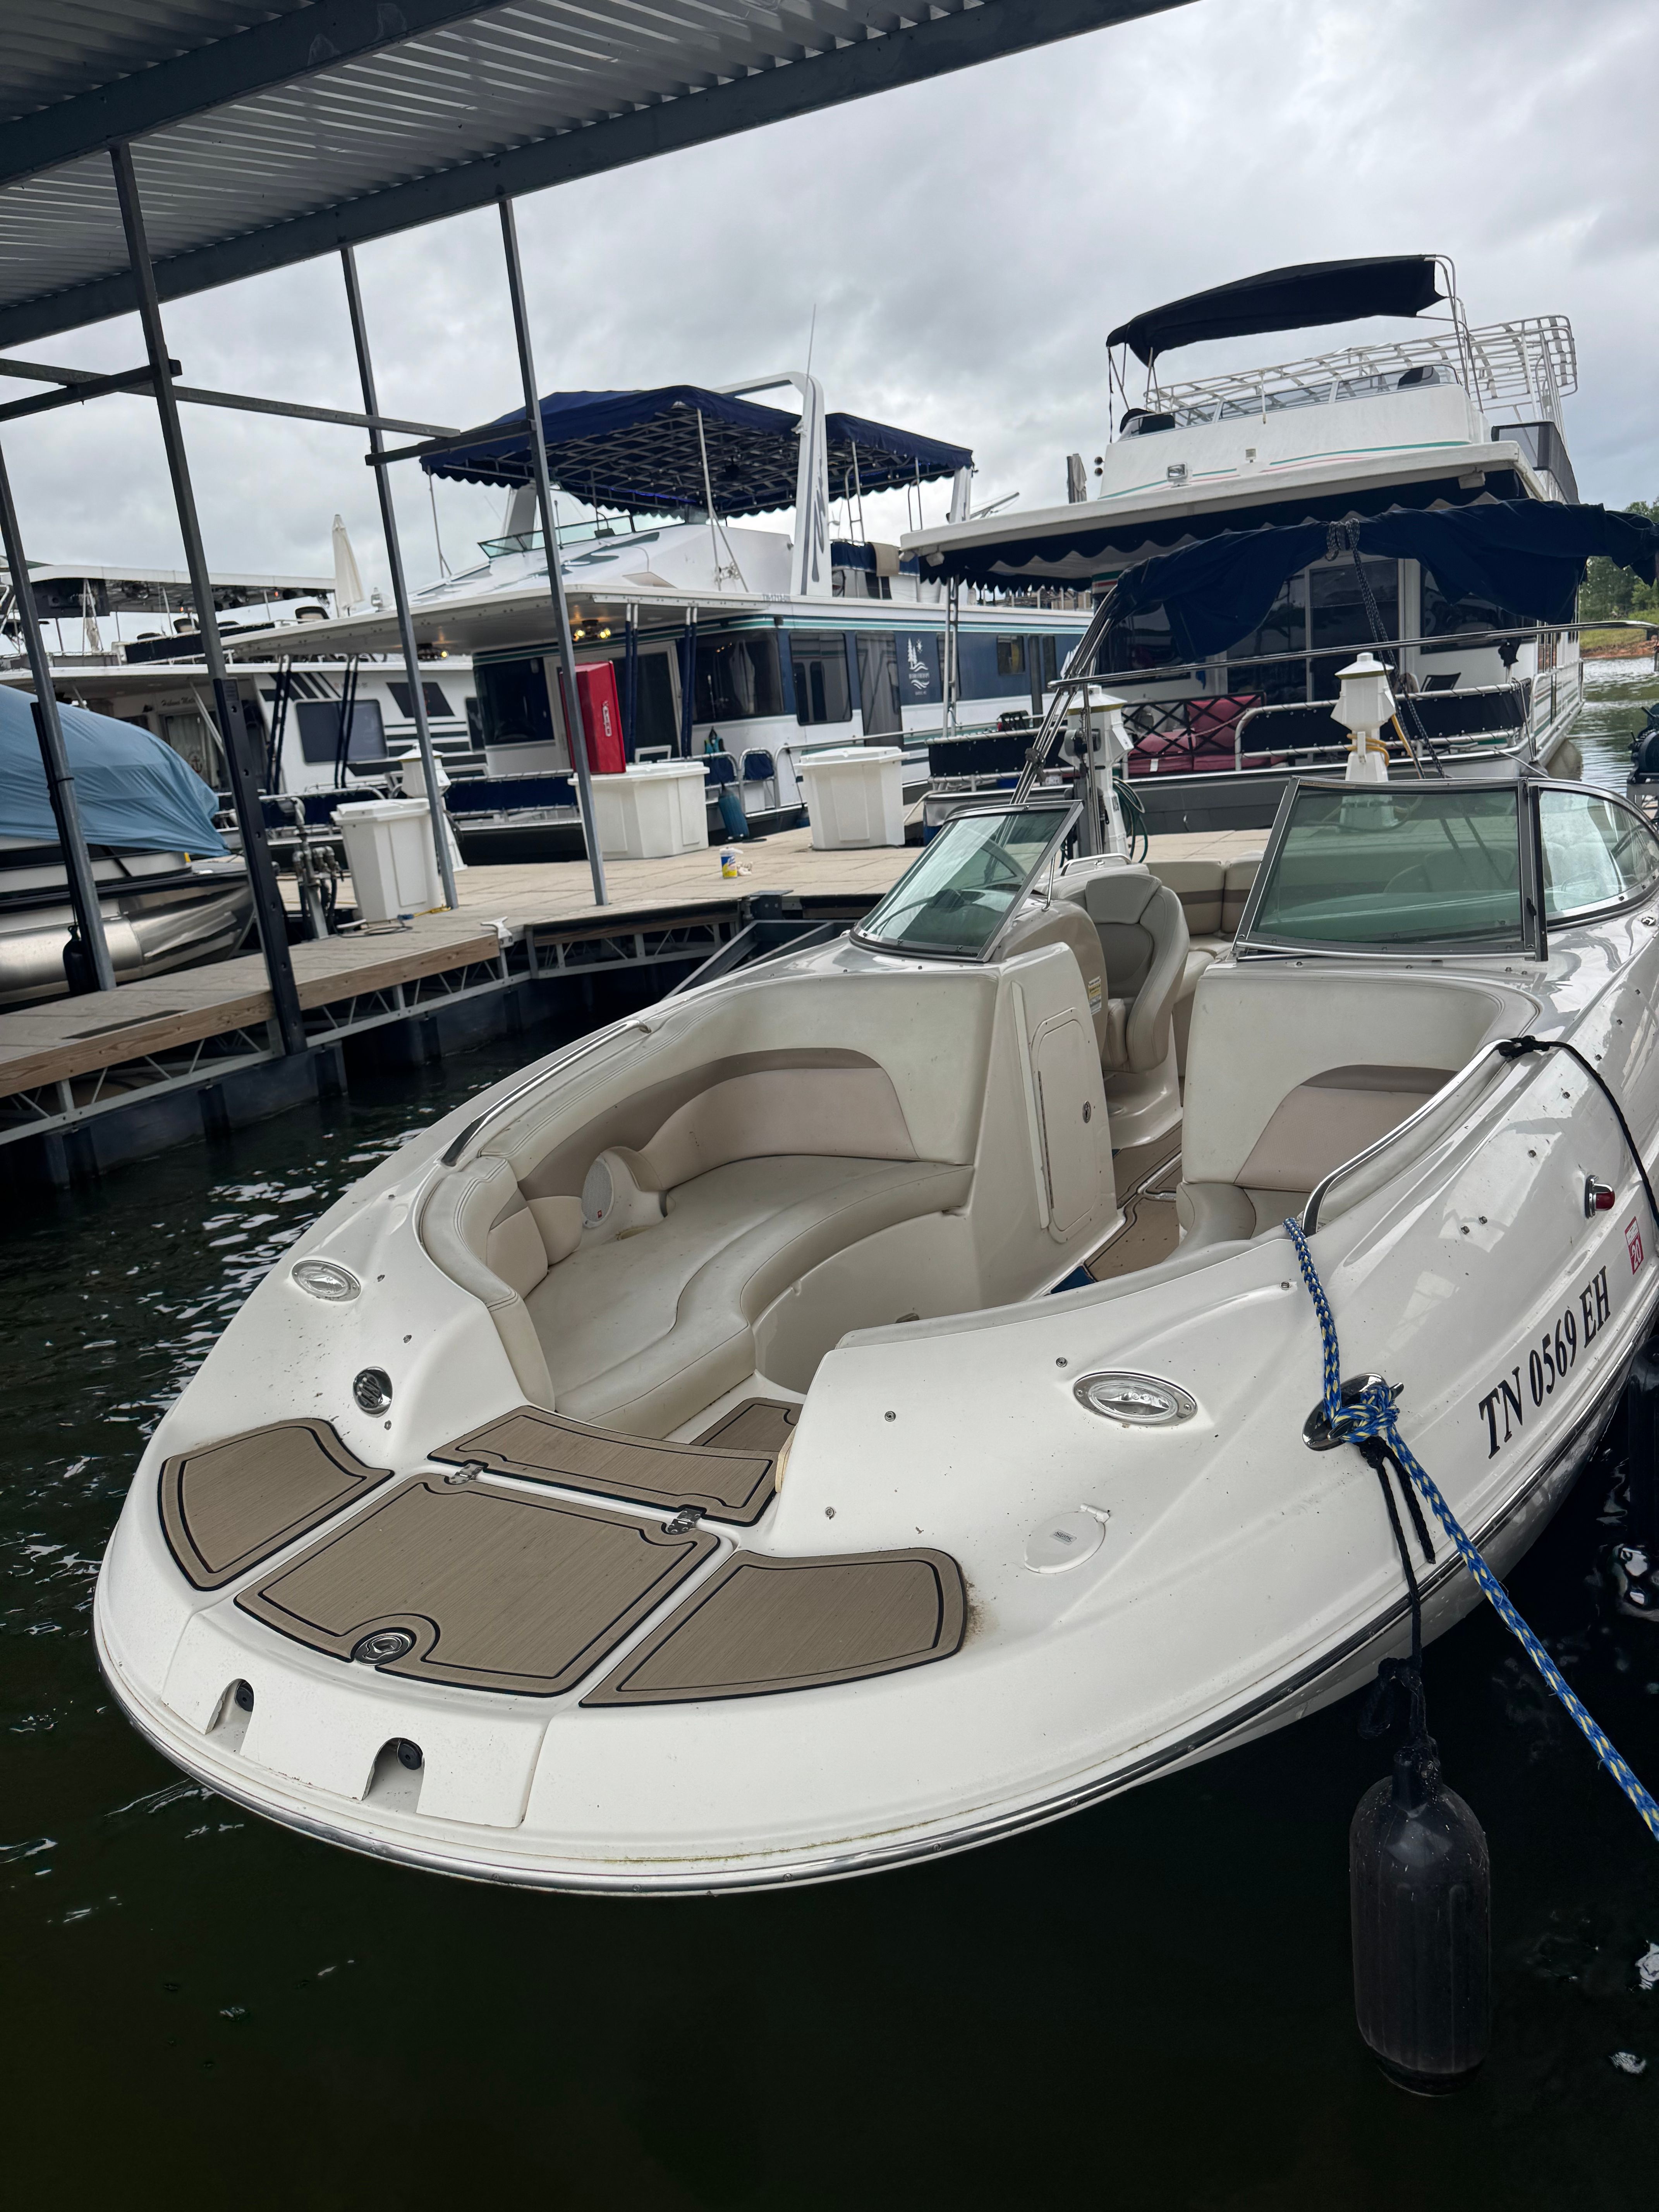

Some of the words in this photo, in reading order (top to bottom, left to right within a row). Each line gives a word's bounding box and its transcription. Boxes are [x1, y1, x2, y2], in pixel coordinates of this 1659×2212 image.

[1631, 1238, 1642, 1271] 20
[1479, 1366, 1523, 1460] TN
[1529, 1310, 1577, 1407] 0569
[1579, 1265, 1611, 1349] EH
